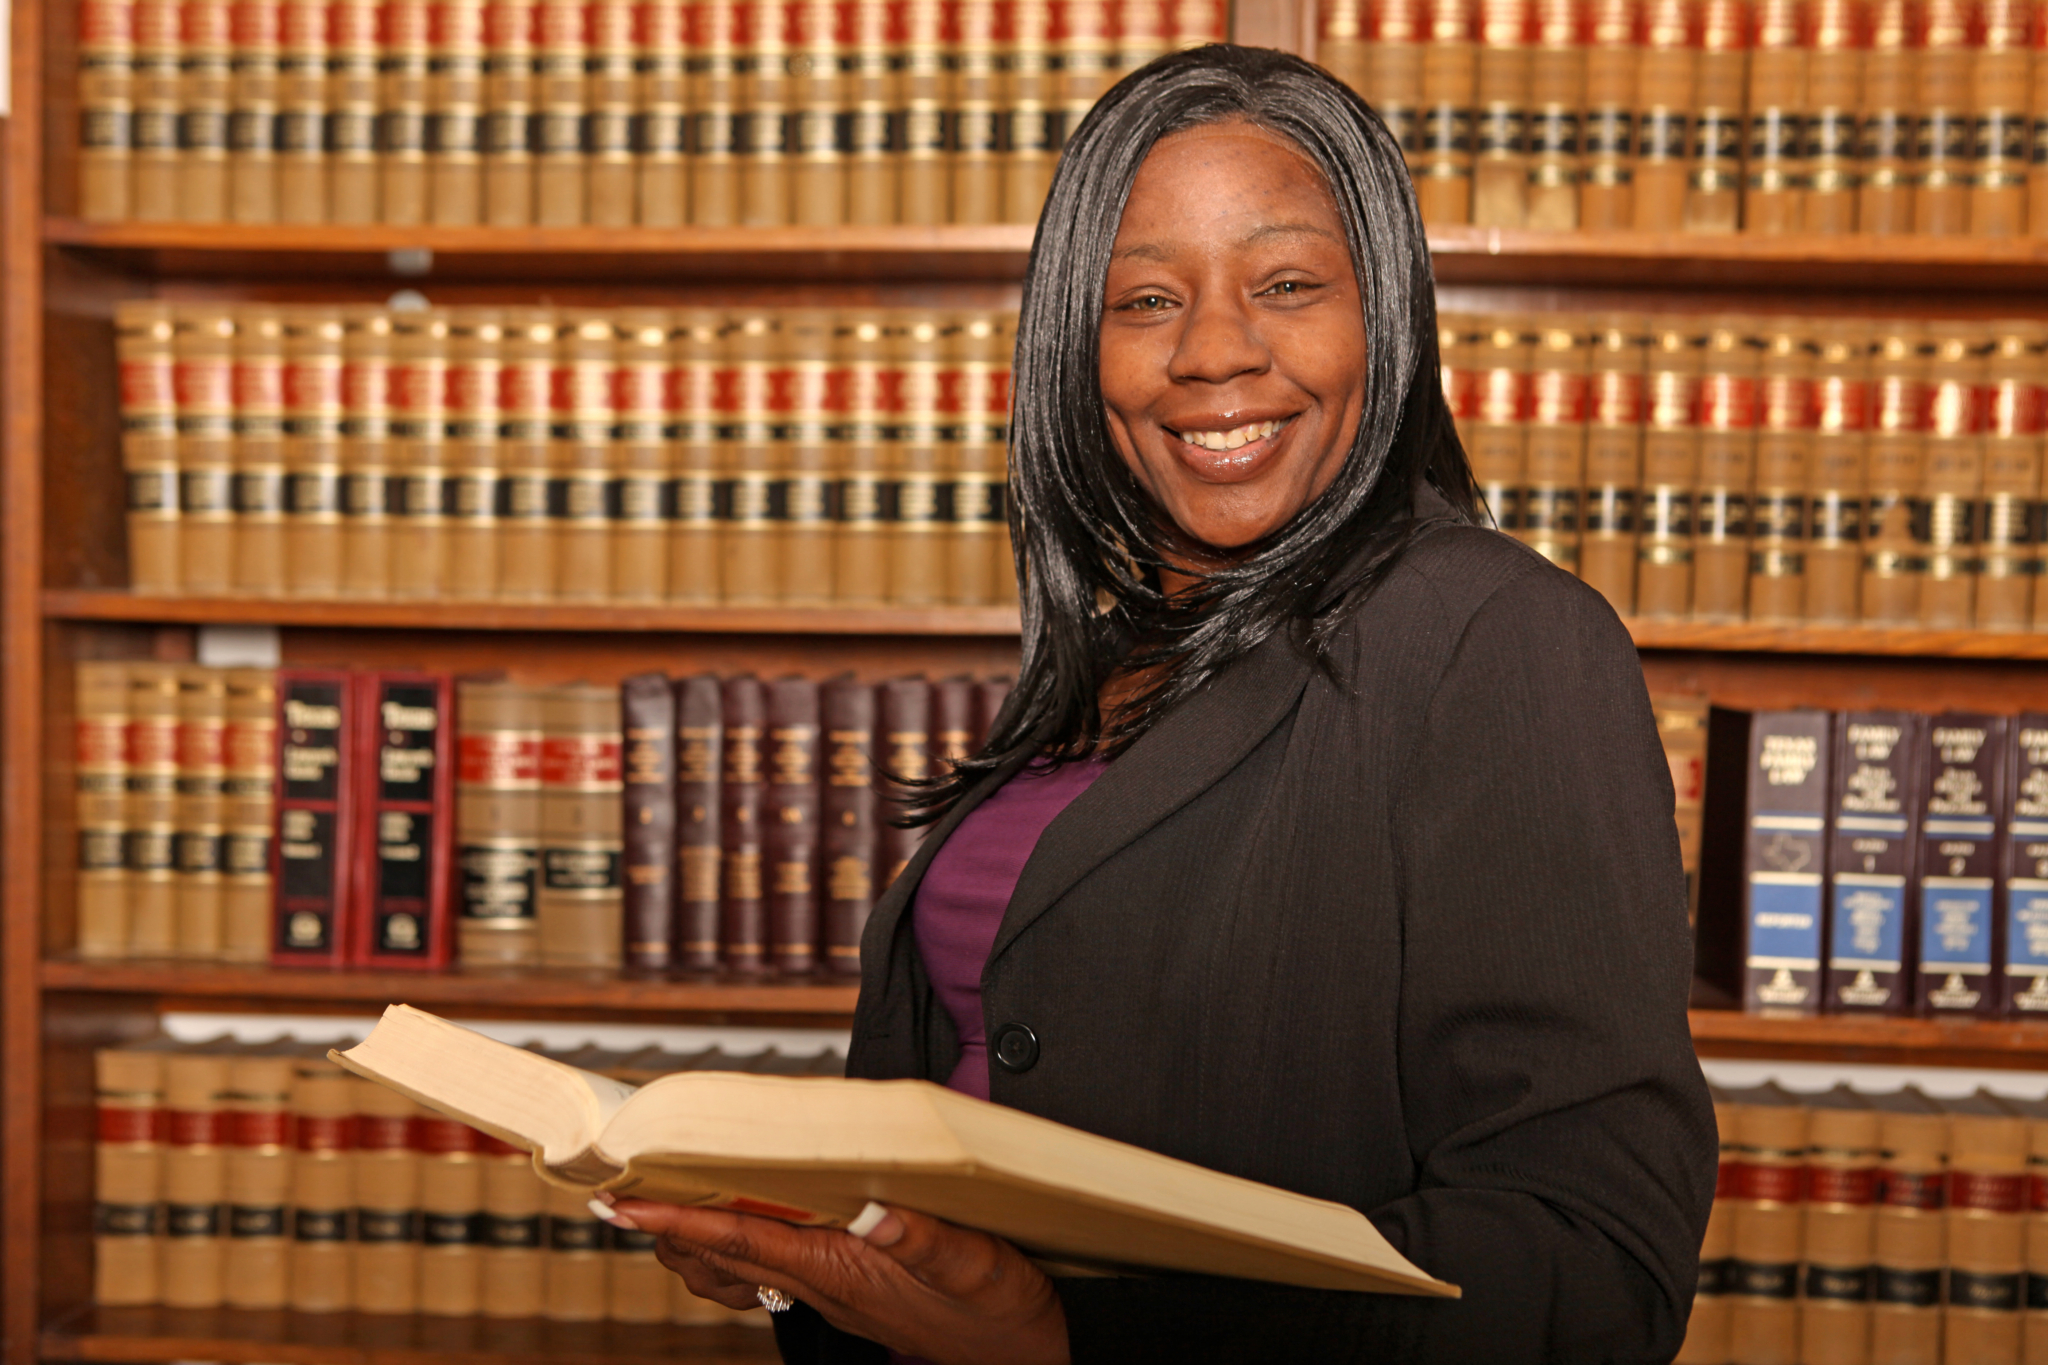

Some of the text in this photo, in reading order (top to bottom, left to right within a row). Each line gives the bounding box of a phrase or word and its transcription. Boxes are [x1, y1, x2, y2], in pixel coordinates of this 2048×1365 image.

[1855, 742, 1893, 761] LAW
[1941, 745, 1979, 764] LAW
[1768, 767, 1807, 785] LAW
